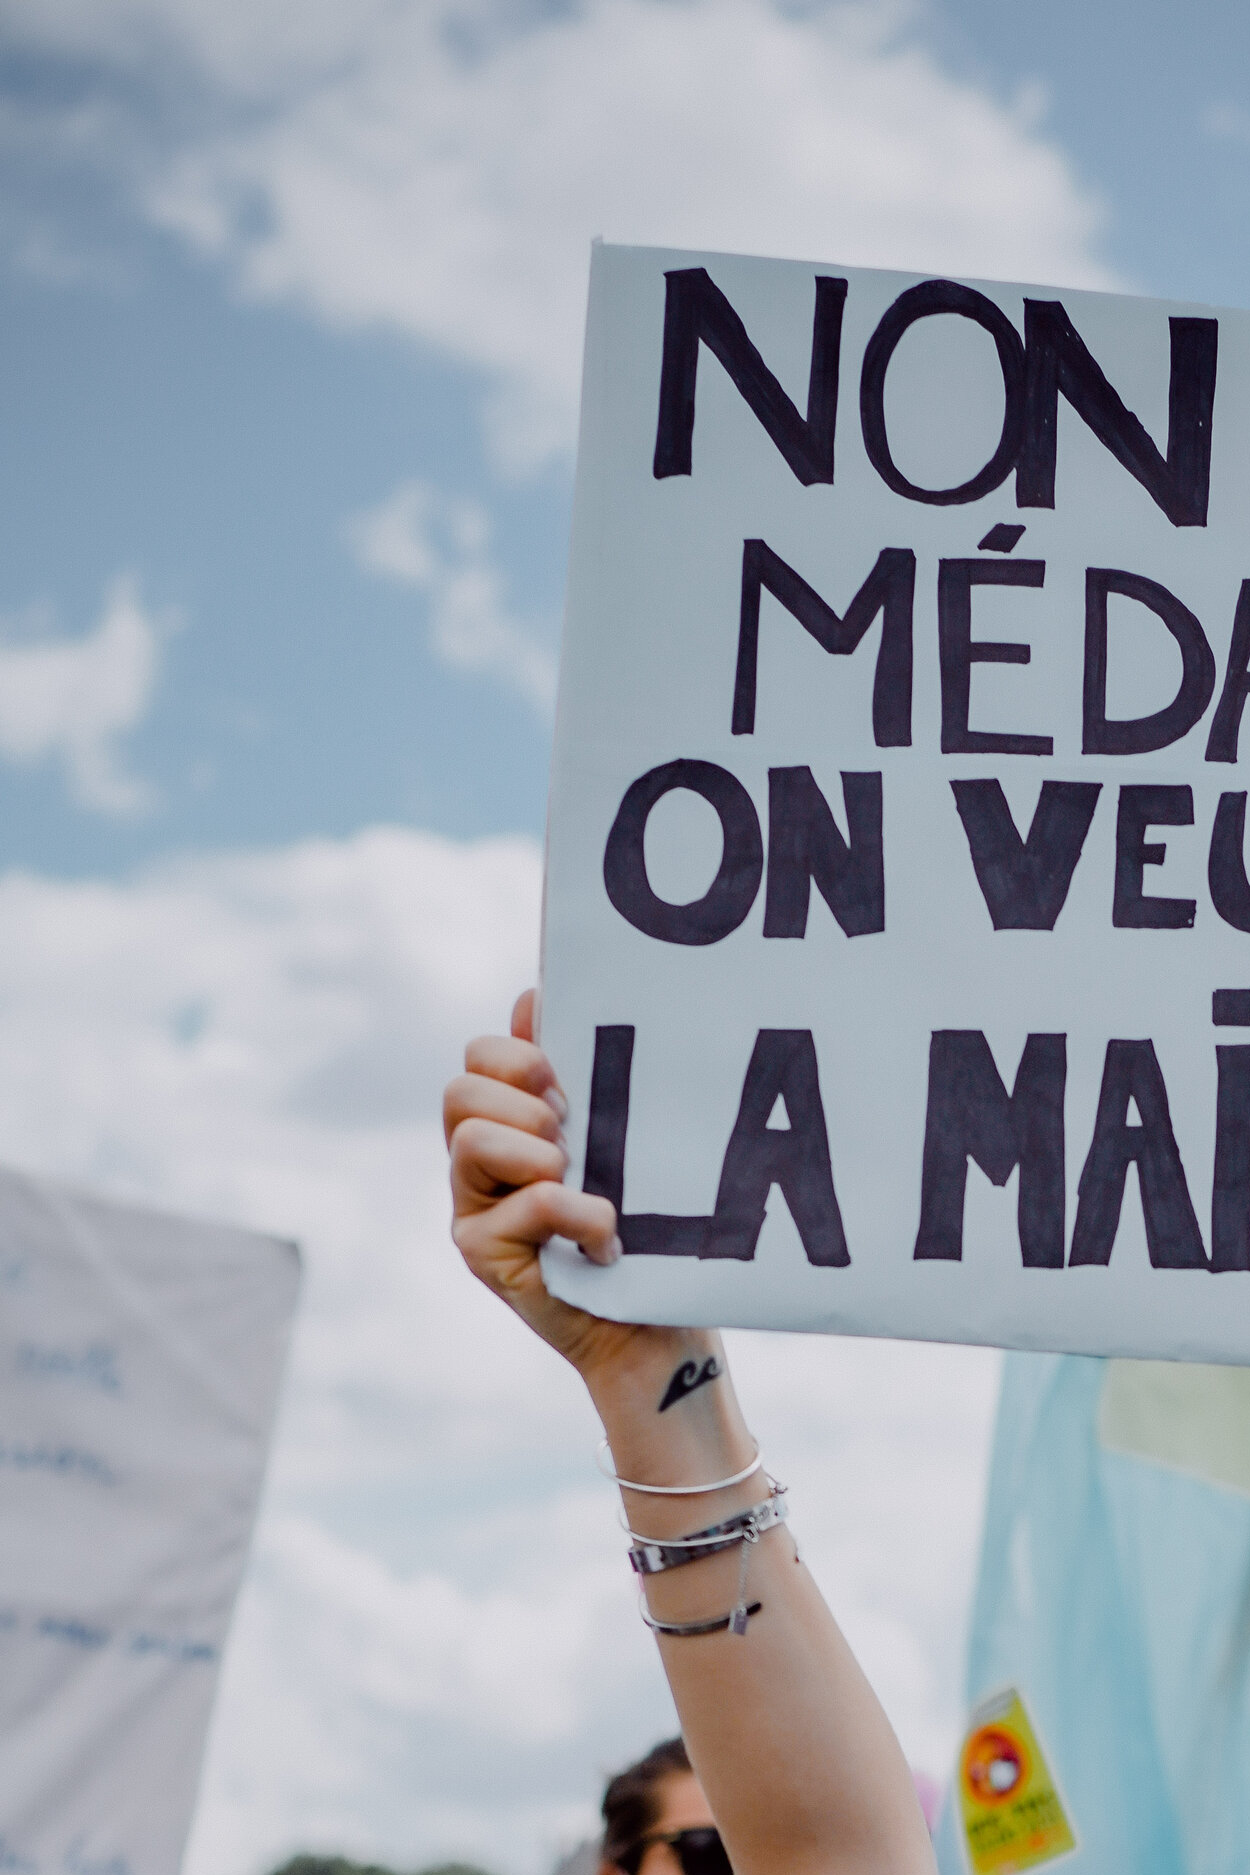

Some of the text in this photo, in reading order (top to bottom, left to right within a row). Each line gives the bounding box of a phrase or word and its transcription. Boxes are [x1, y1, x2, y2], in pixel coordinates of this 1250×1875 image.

[654, 267, 1218, 528] NON
[603, 758, 885, 946] ON
[578, 1024, 851, 1268] LA
